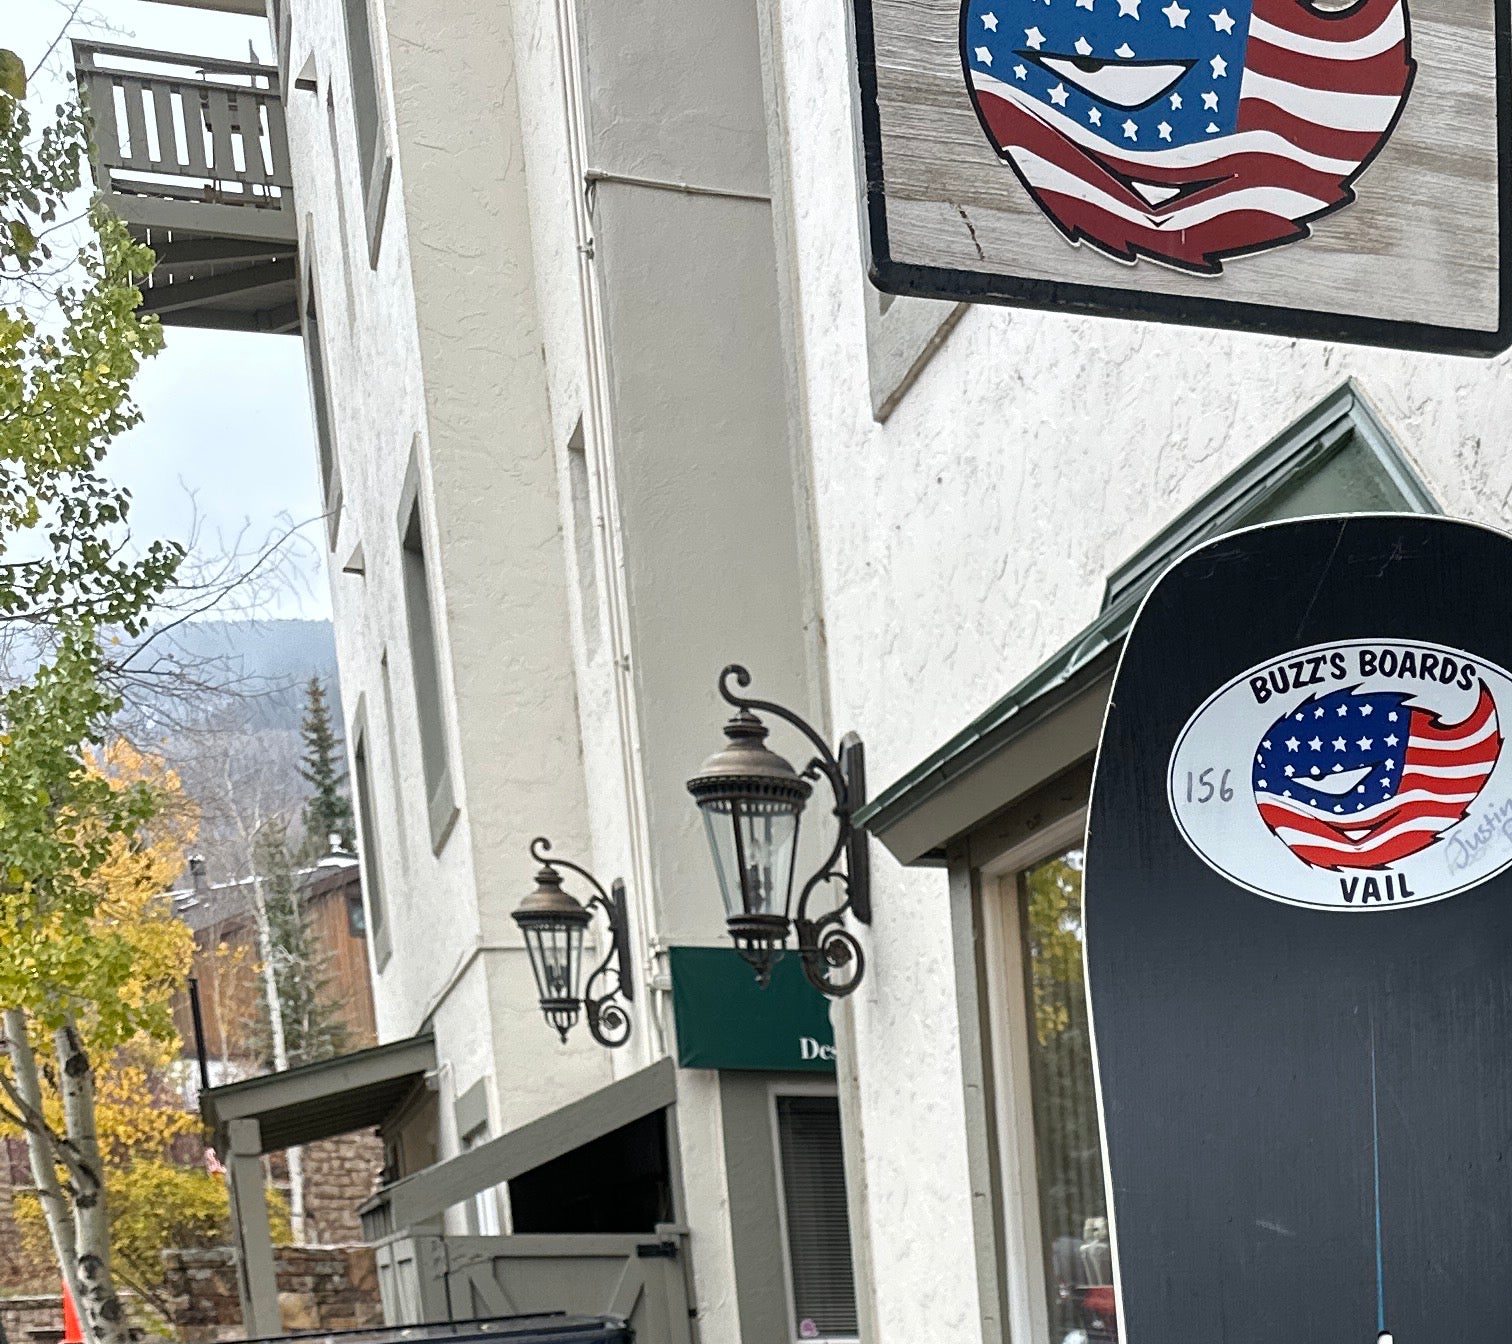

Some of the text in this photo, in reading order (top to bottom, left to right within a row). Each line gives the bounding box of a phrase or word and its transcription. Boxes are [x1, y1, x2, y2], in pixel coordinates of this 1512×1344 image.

[1249, 649, 1477, 704] BUZZ'S BOARDS
[1187, 768, 1234, 803] 156
[1340, 872, 1415, 903] VAIL
